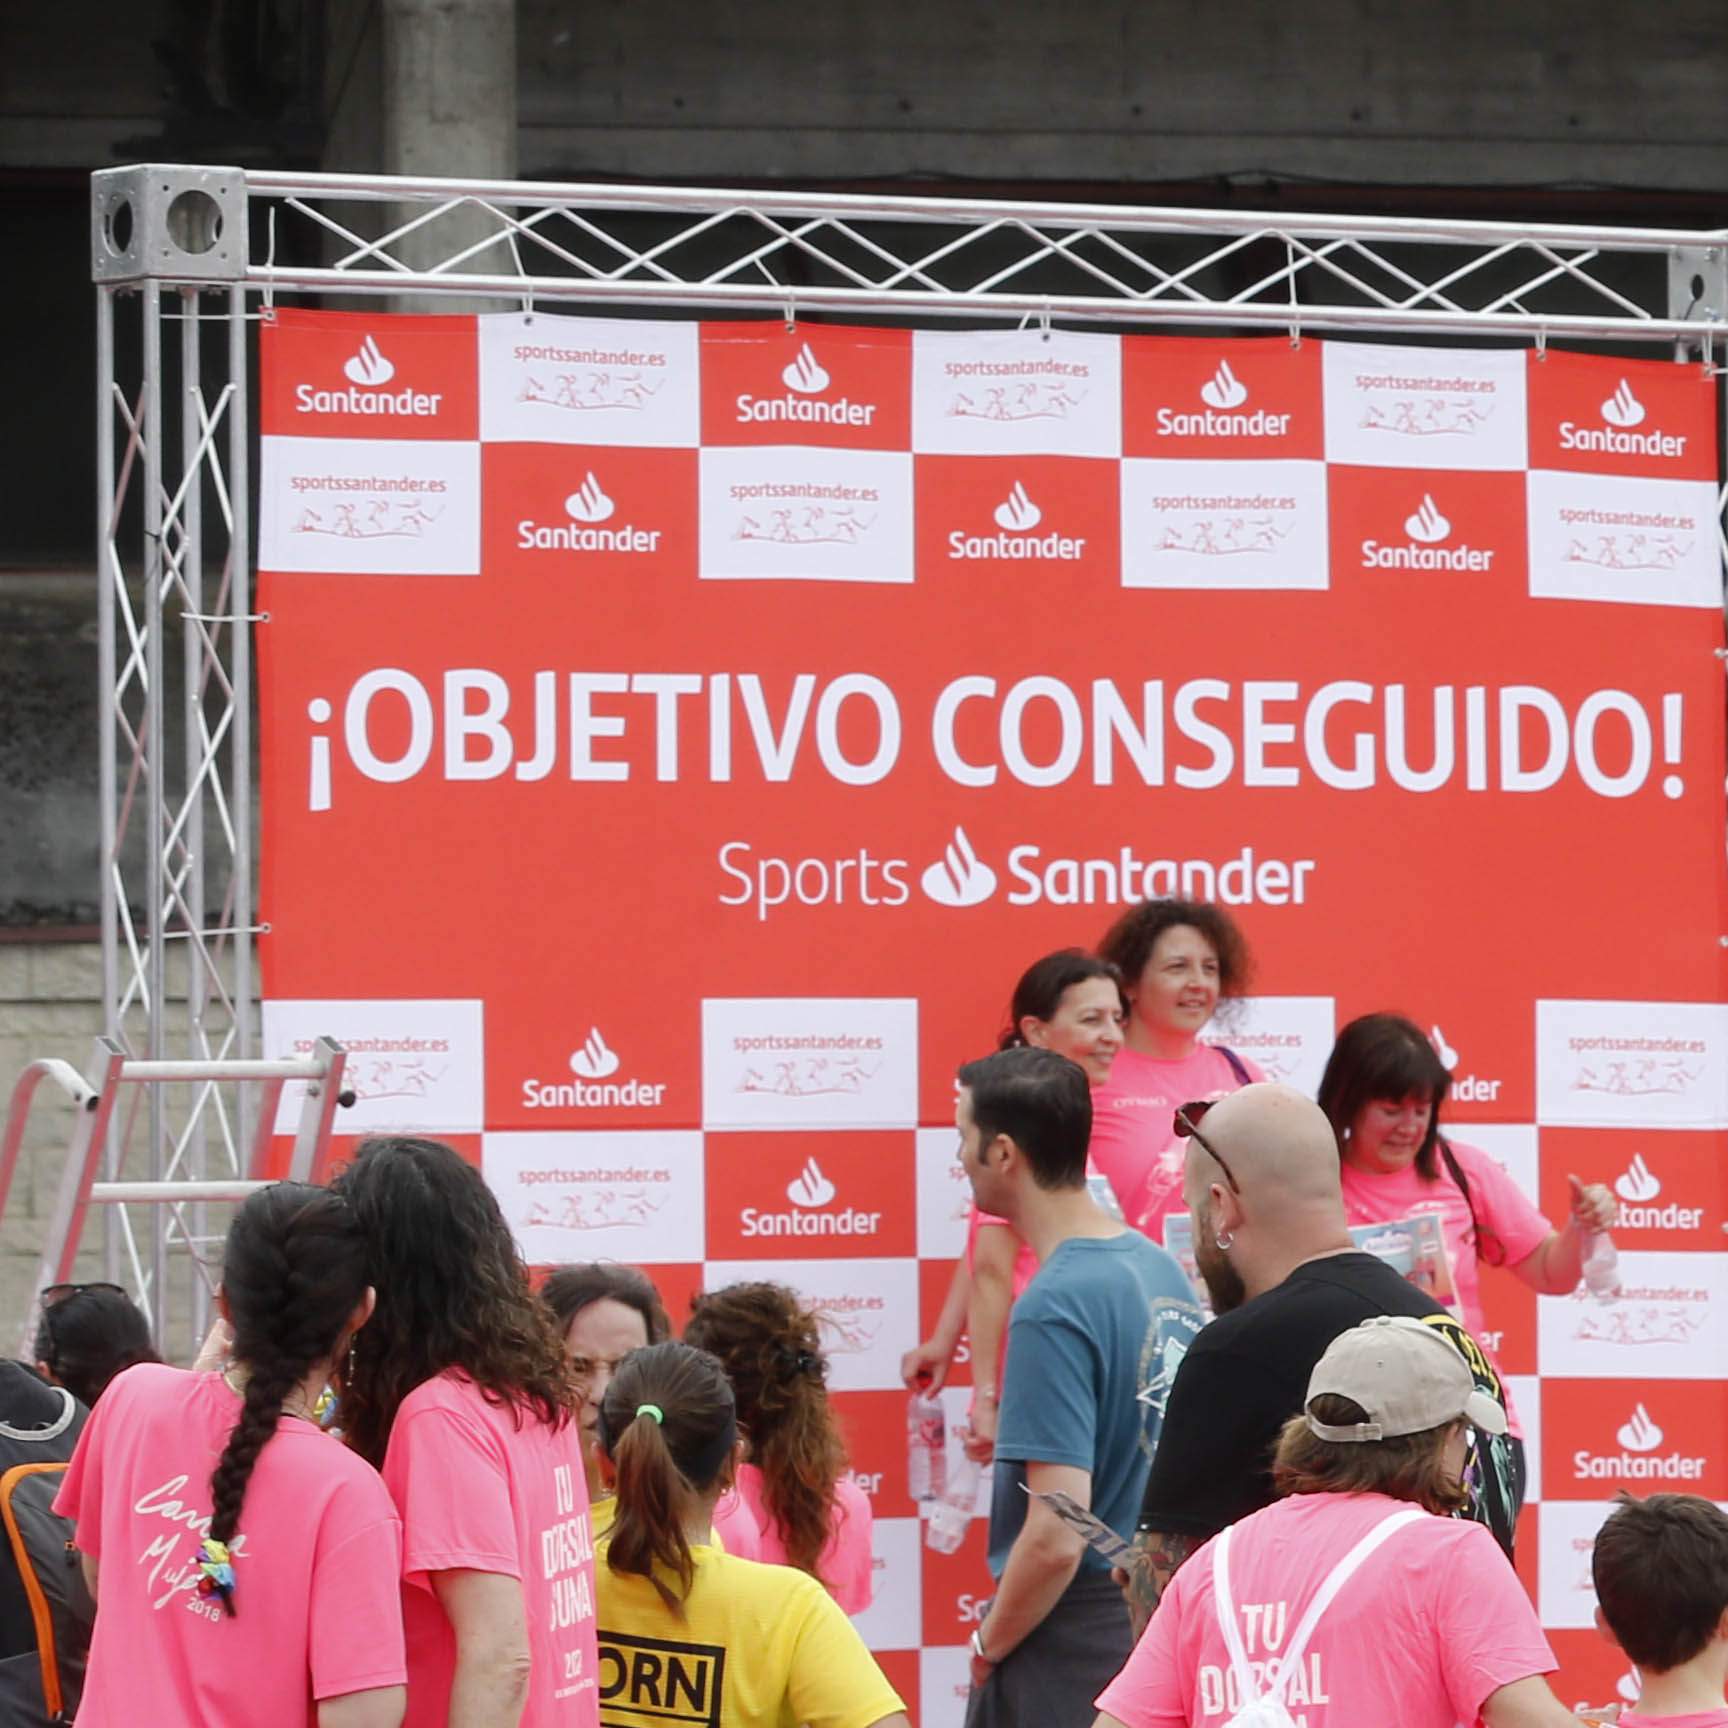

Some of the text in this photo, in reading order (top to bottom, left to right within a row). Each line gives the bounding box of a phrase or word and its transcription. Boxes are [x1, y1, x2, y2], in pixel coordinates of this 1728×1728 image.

[514, 342, 666, 367] sportssantander.es
[945, 358, 1089, 378] sportssantander.es
[1355, 373, 1496, 395] sportssantander.es
[296, 386, 441, 417] Santander
[736, 394, 875, 426] Santander
[1157, 409, 1290, 436] Santander
[1559, 422, 1686, 456] Santander
[291, 474, 446, 496] sportssantander.es
[730, 481, 879, 502] sportssantander.es
[1152, 492, 1296, 514] sportssantander.es
[1559, 506, 1694, 531] sportssantander.es
[517, 521, 661, 553] Santander
[949, 531, 1085, 560] Santander
[1362, 541, 1493, 571] Santander
[307, 667, 1684, 811] ¡OBJETIVO CONSEGUIDO!
[719, 841, 1315, 921] Sports Santander
[733, 1033, 883, 1052] sportssantander.es
[1569, 1035, 1706, 1054] sportssantander.es
[522, 1079, 666, 1108] Santander
[518, 1165, 670, 1185] sportssantander.es
[740, 1208, 880, 1236] Santander
[1574, 1450, 1704, 1480] Santander
[186, 1597, 221, 1622] 2018
[1241, 1601, 1287, 1654] TU
[598, 1647, 710, 1714] ORN
